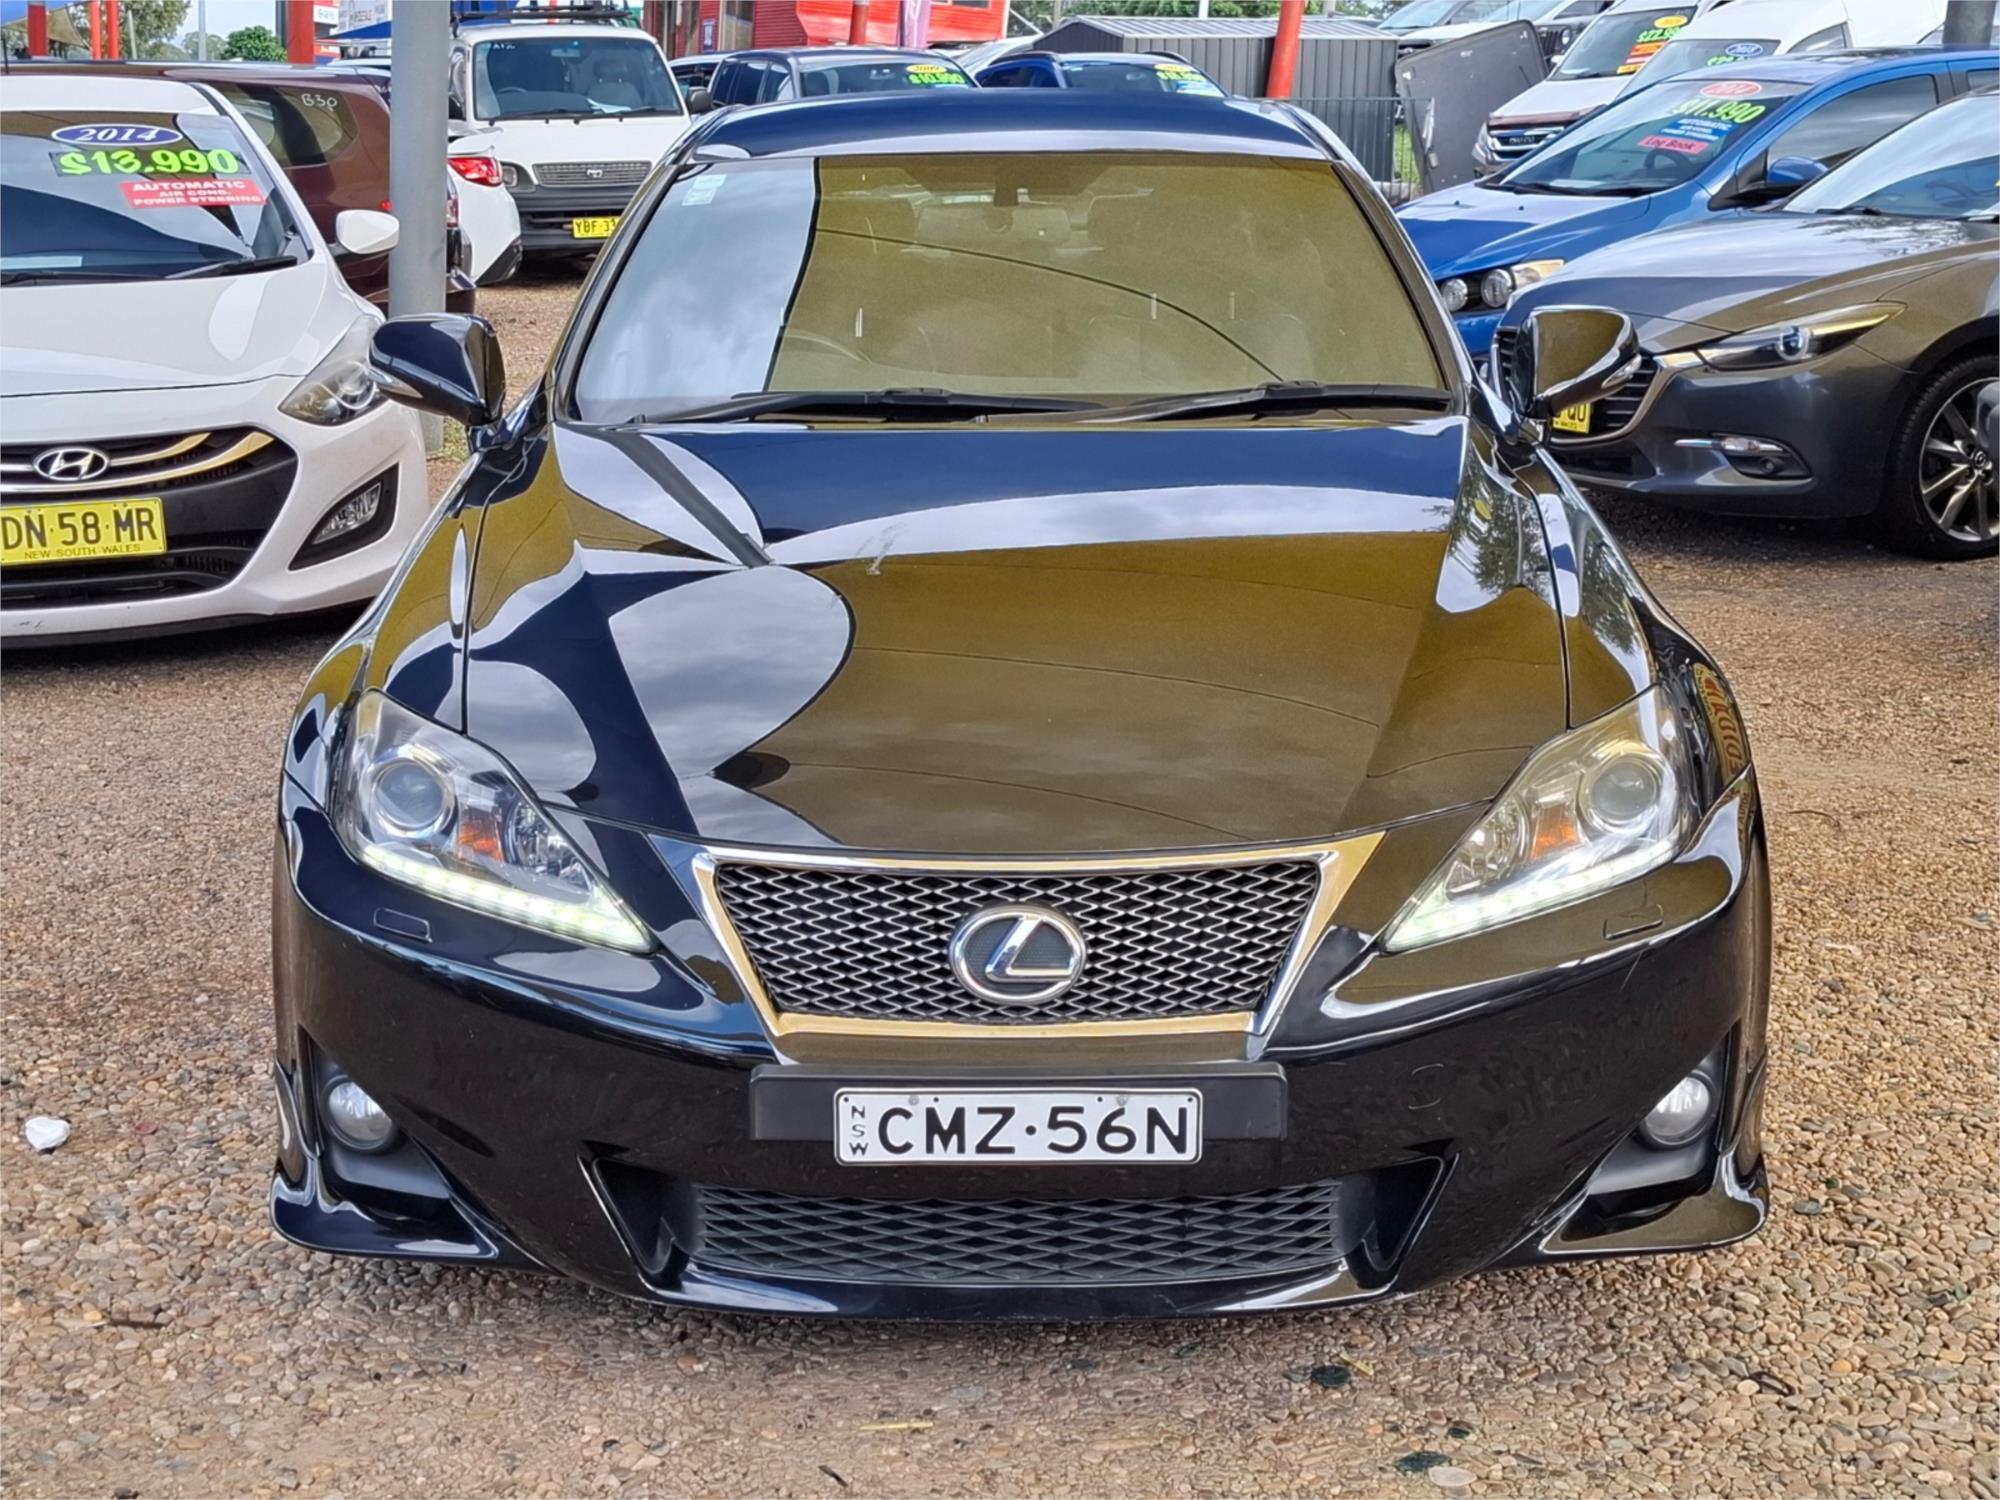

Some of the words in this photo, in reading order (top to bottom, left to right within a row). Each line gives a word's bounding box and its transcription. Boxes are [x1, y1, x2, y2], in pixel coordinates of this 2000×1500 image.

[74, 127, 159, 142] 2014
[1669, 139, 1696, 151] Book
[59, 148, 239, 175] $13.990
[132, 179, 247, 192] AUTOMATIC
[133, 197, 186, 206] POWER
[189, 195, 263, 204] STEERING
[24, 550, 51, 560] NEW
[56, 547, 96, 558] SOUTH
[102, 543, 142, 554] WALES
